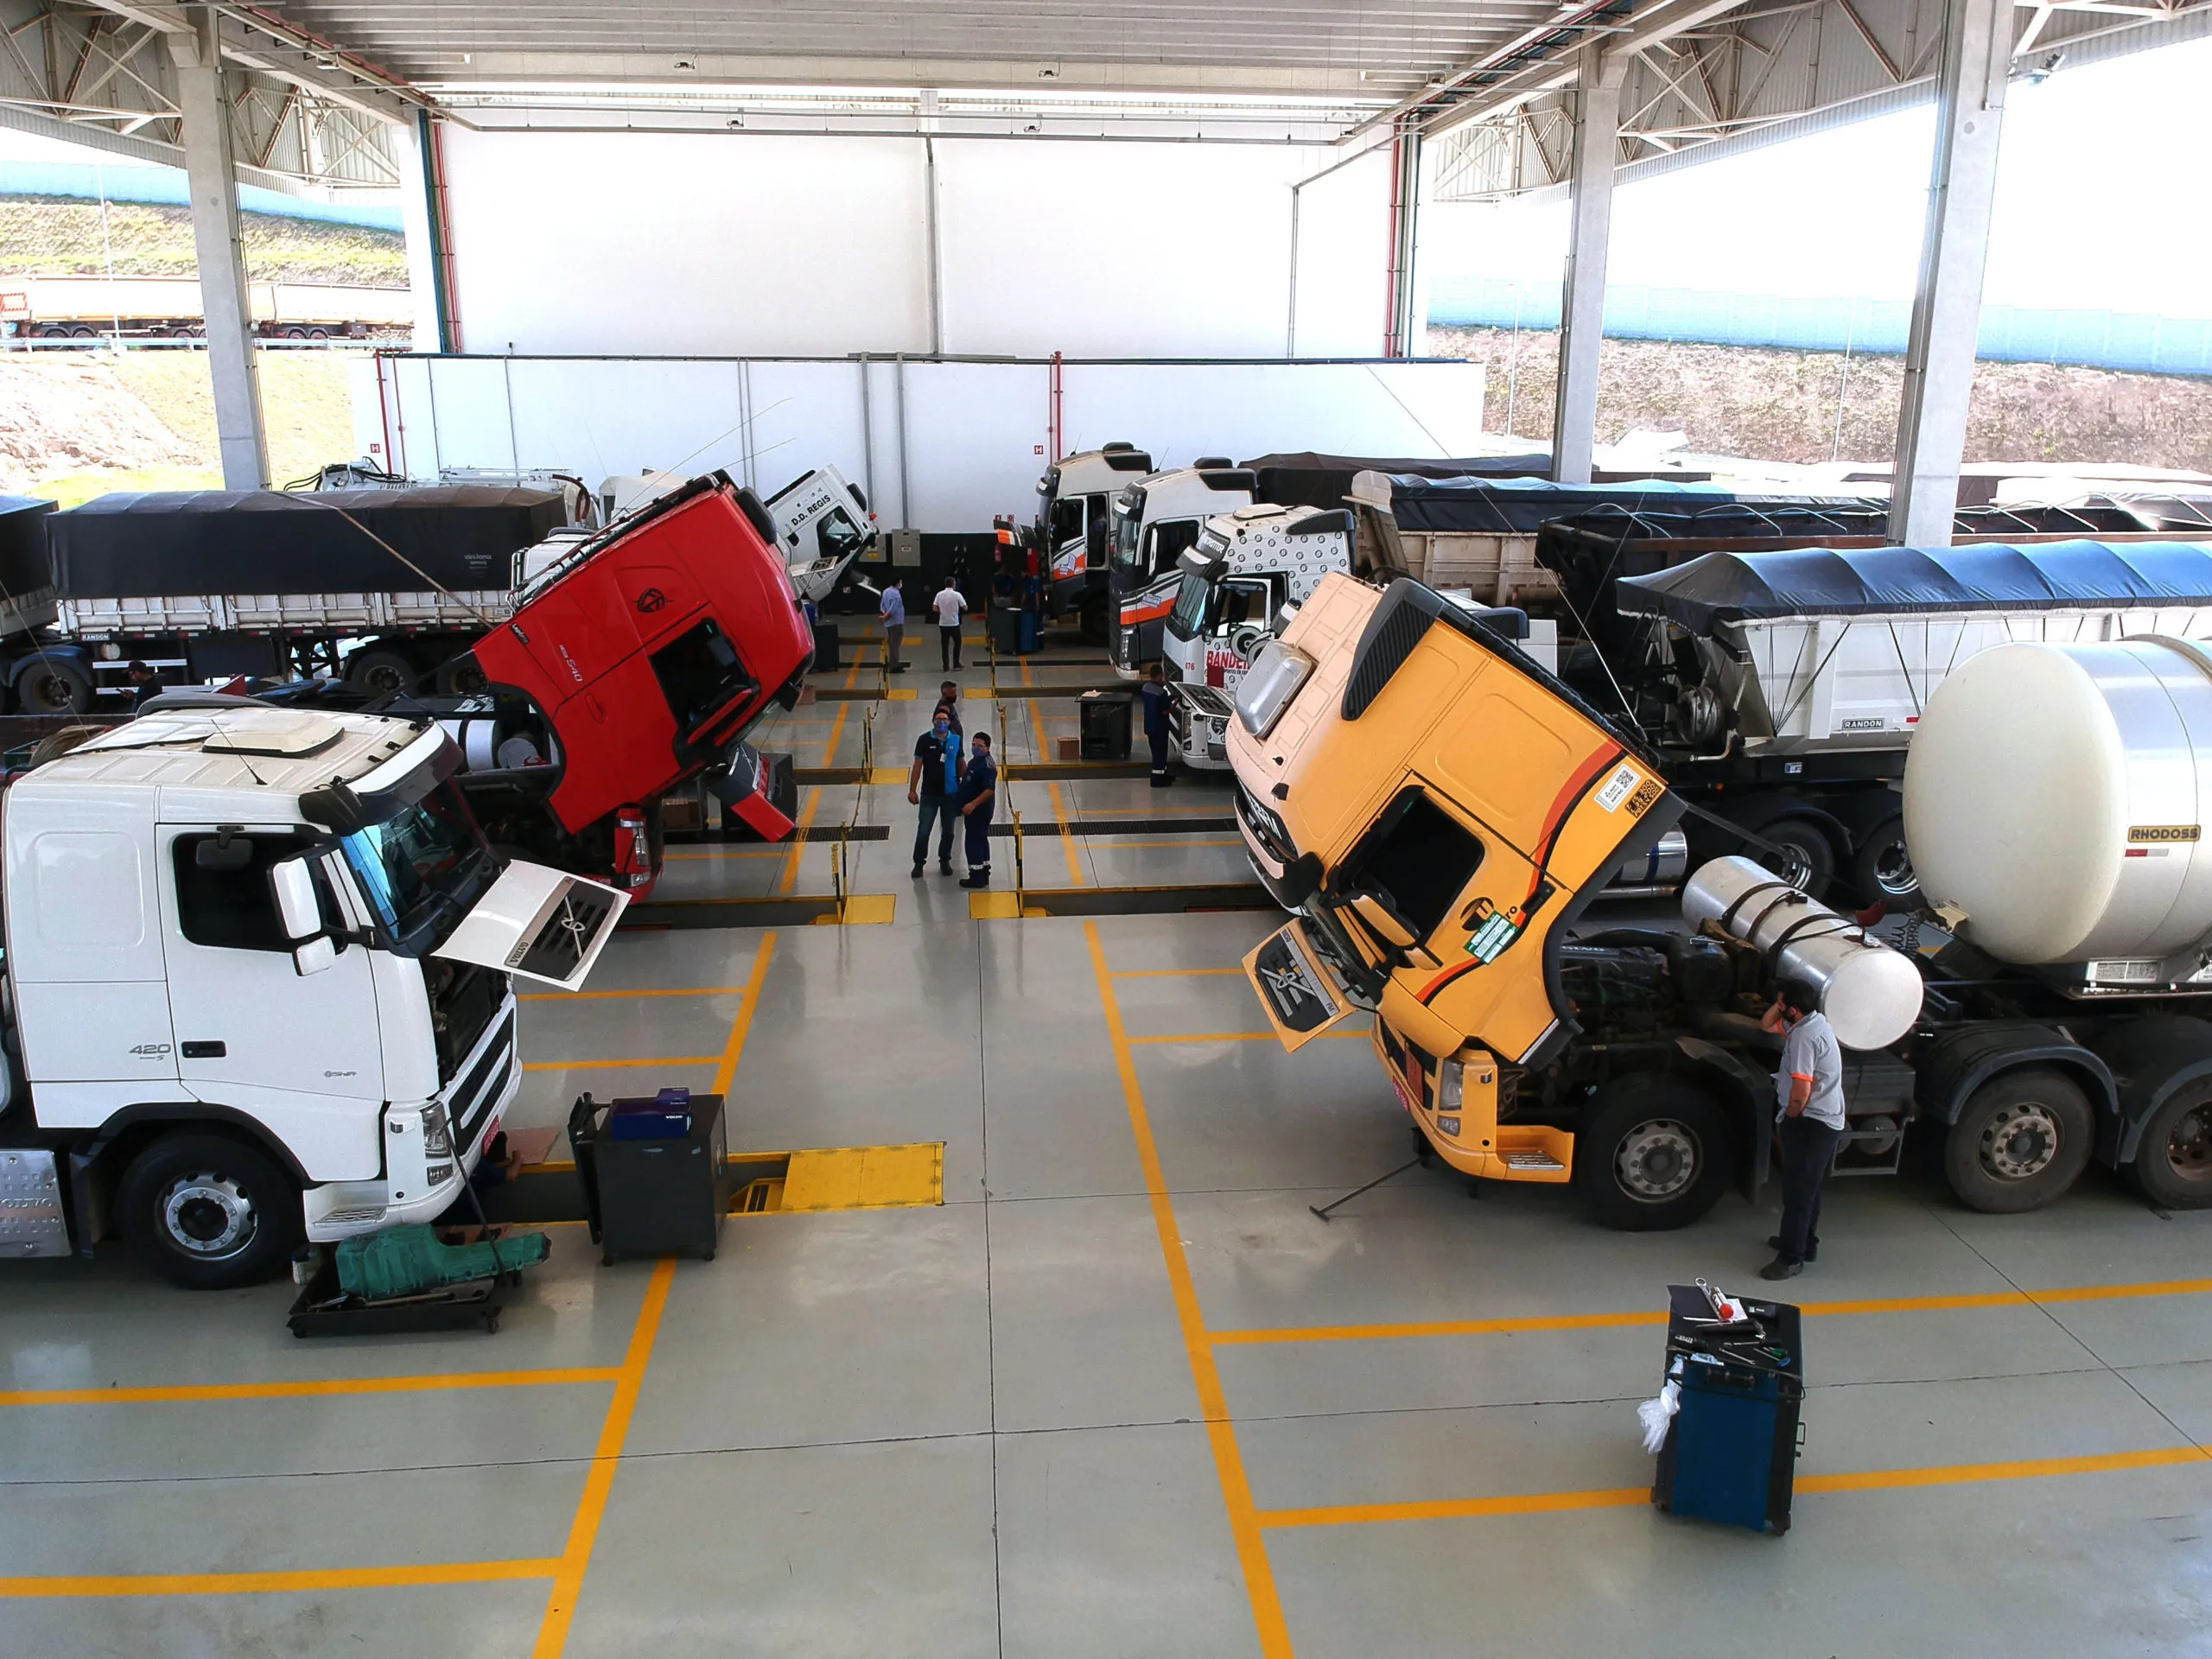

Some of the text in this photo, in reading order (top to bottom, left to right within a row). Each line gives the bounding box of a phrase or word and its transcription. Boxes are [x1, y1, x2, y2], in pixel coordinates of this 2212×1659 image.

[791, 495, 831, 525] D.D. REGIS
[1207, 651, 1250, 670] BANDEI
[2131, 829, 2198, 839] RHODOSS
[510, 942, 530, 963] VOLVO
[129, 1044, 172, 1054] 420
